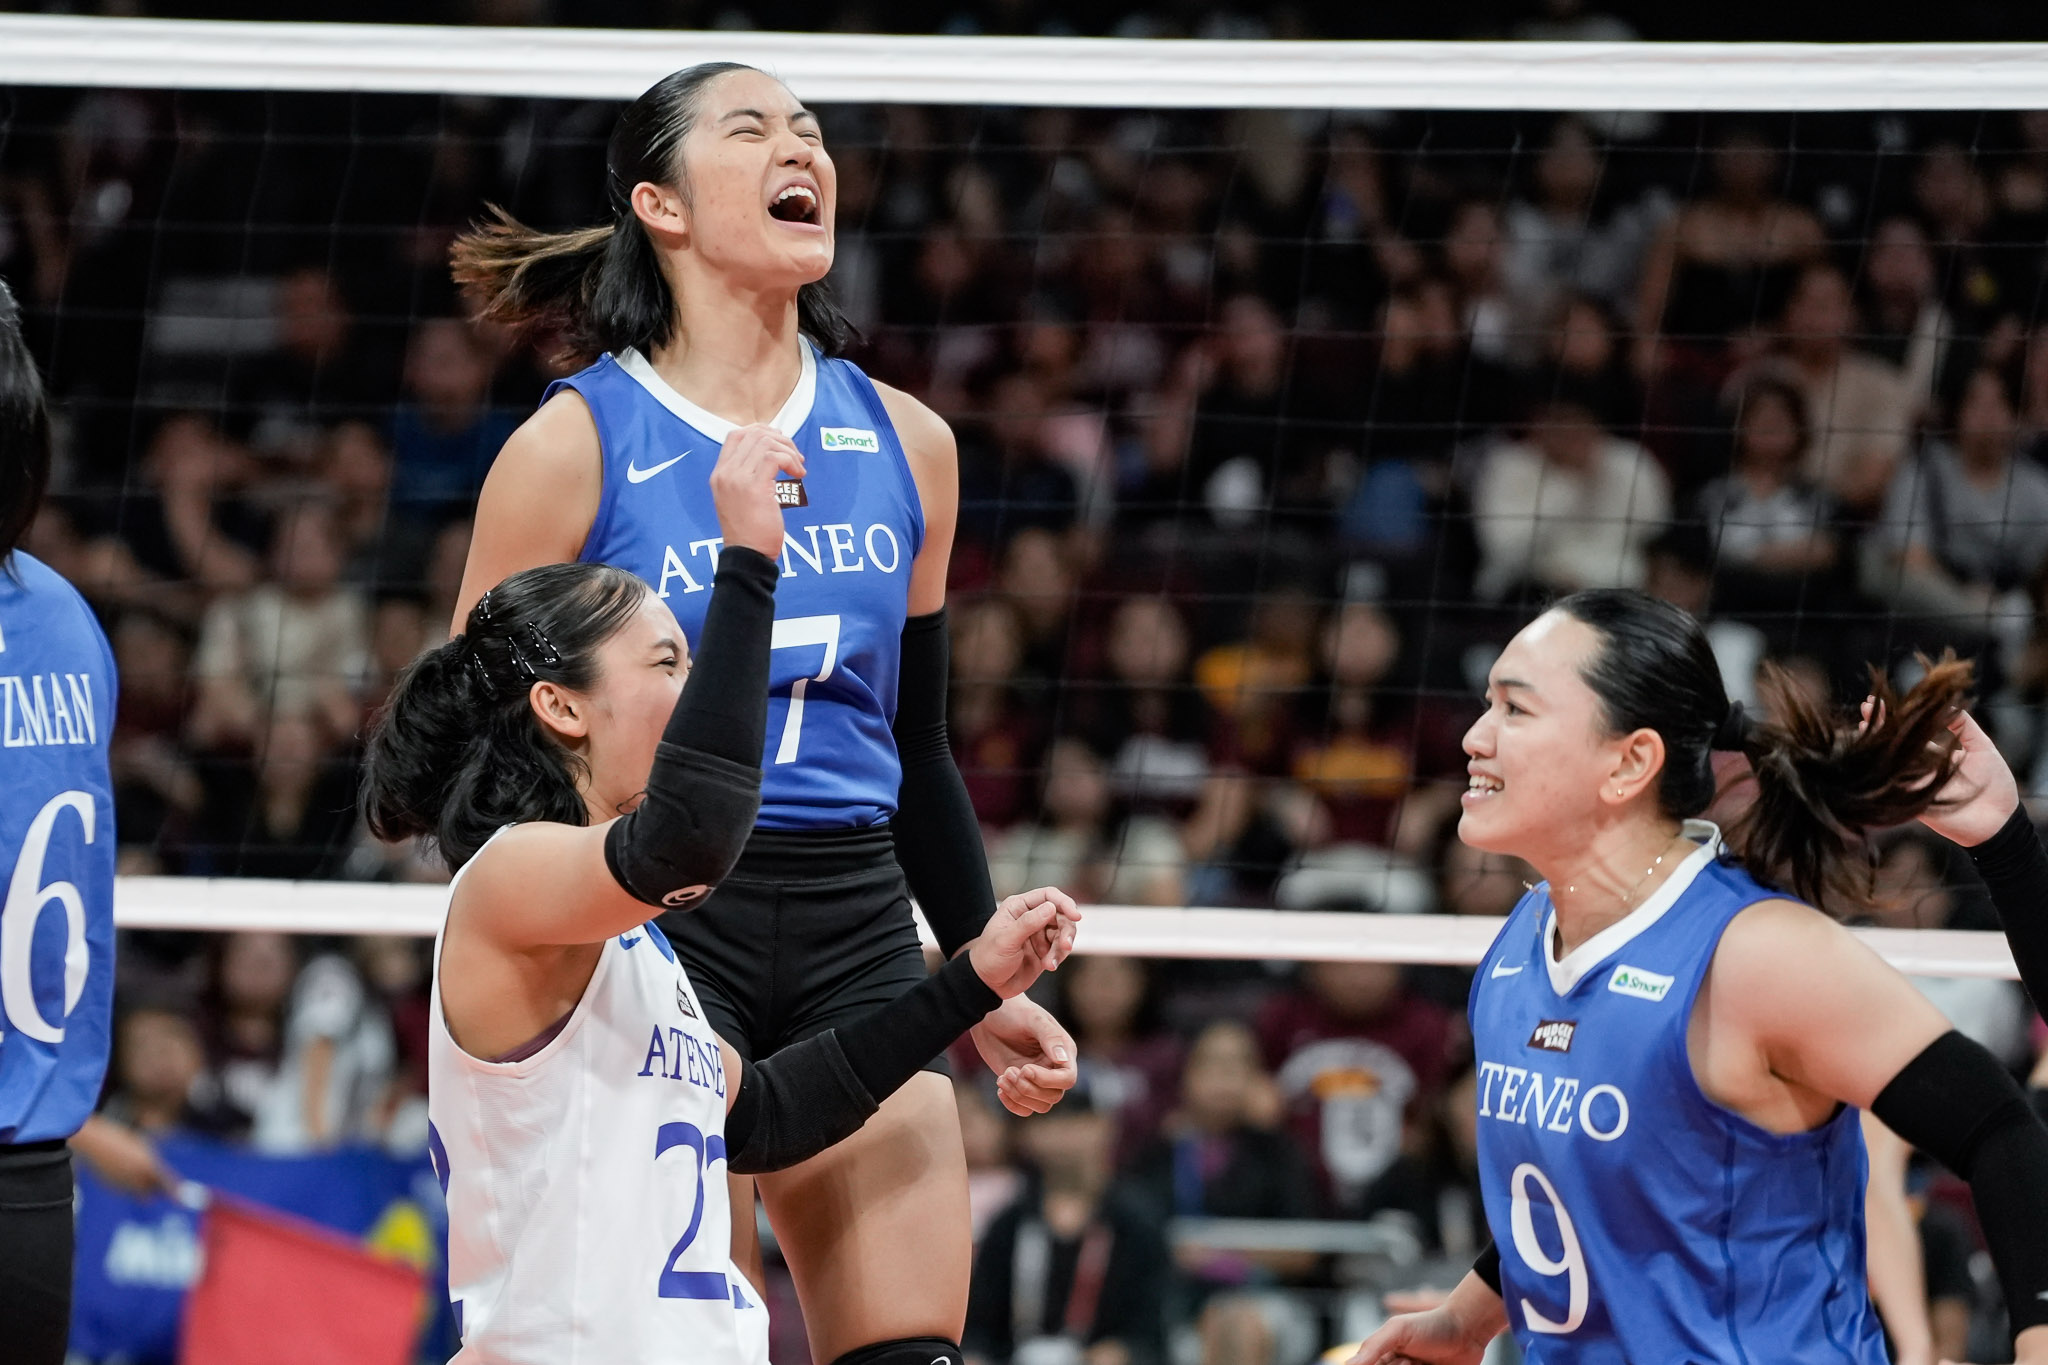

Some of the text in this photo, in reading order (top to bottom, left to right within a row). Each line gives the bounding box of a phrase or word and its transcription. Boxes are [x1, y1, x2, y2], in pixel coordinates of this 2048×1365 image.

[837, 434, 875, 448] Smart
[774, 494, 800, 506] ARR
[775, 482, 800, 495] GEE
[657, 523, 900, 599] ATNEO
[0, 672, 96, 748] ZMAN
[770, 614, 841, 765] 7
[0, 789, 96, 1043] 6
[1629, 976, 1666, 995] Smart
[637, 1023, 725, 1099] ATENE
[1479, 1060, 1630, 1142] TENEO
[1510, 1162, 1590, 1335] 9
